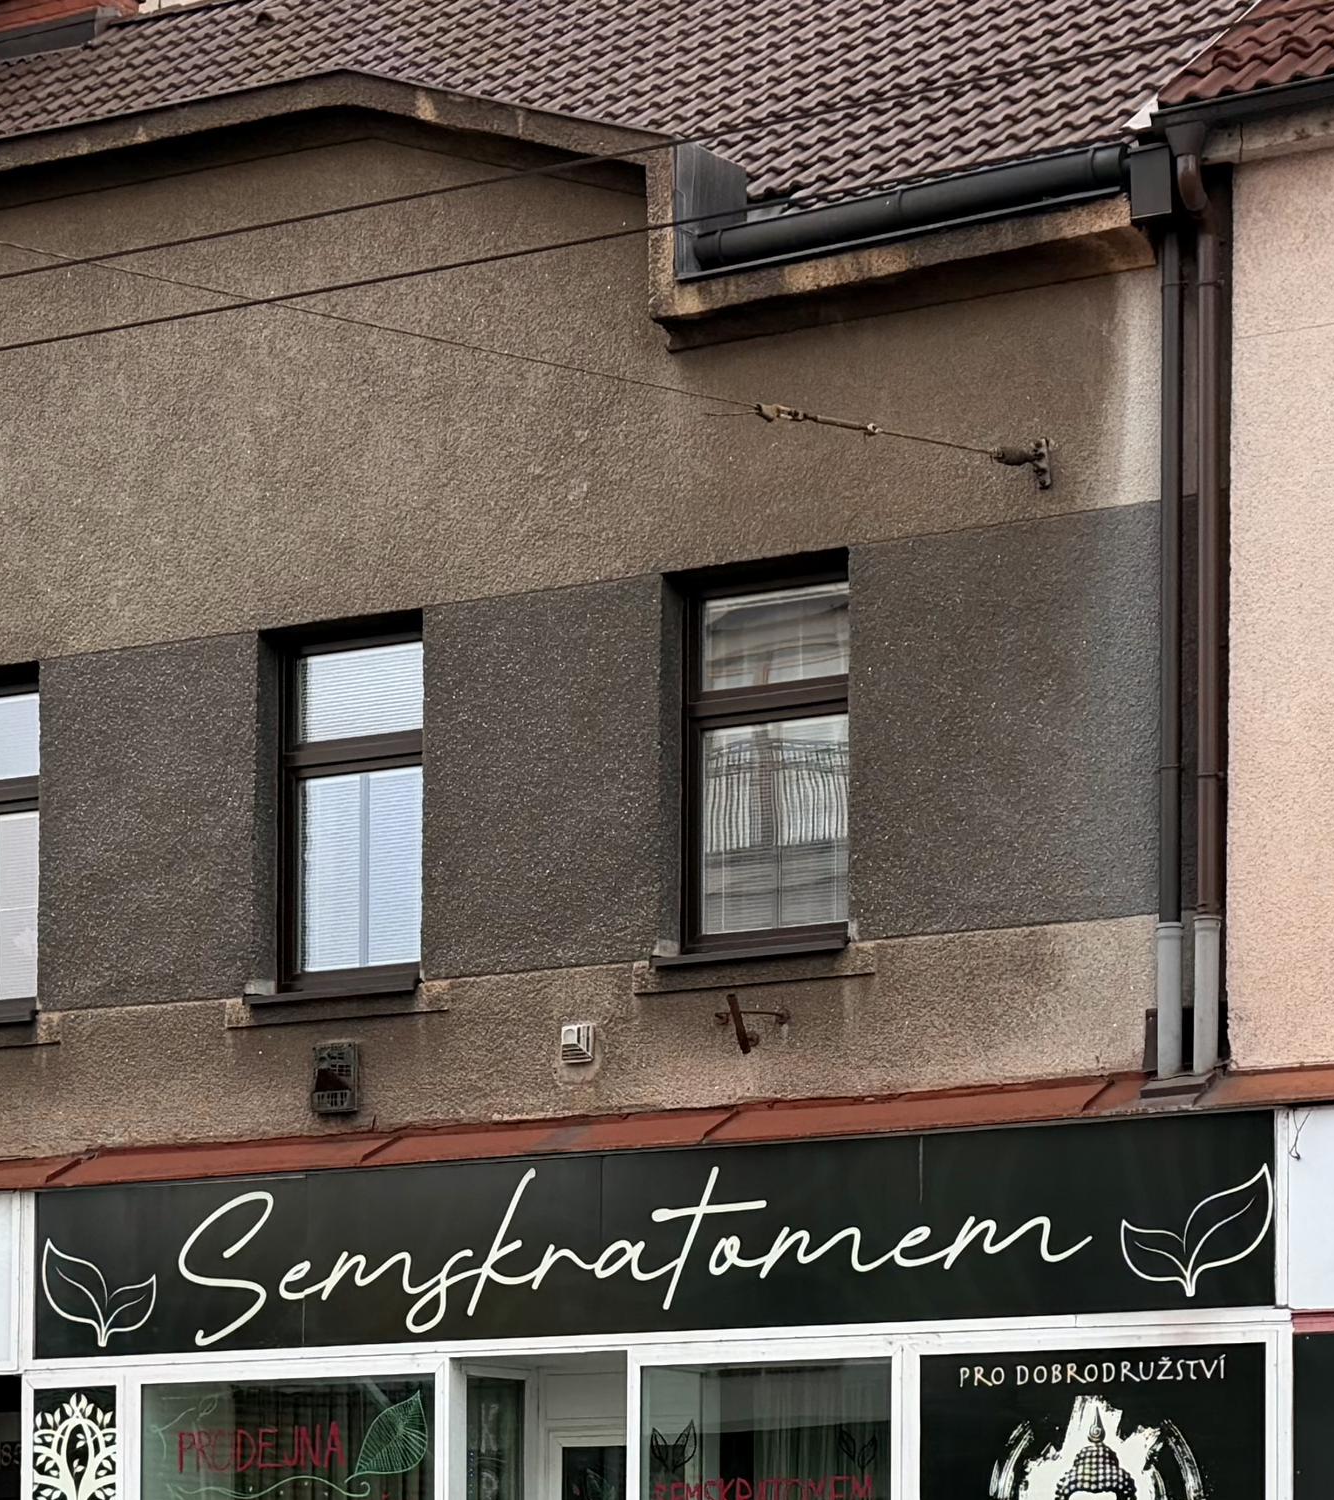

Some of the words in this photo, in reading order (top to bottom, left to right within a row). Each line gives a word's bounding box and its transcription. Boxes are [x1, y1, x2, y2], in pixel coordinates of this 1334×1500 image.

[177, 1165, 1093, 1346] Semskratomem
[959, 1366, 1006, 1388] PRO
[1016, 1354, 1227, 1386] DOBRODRUŽSTVÍ
[177, 1421, 348, 1473] PRODEJNA
